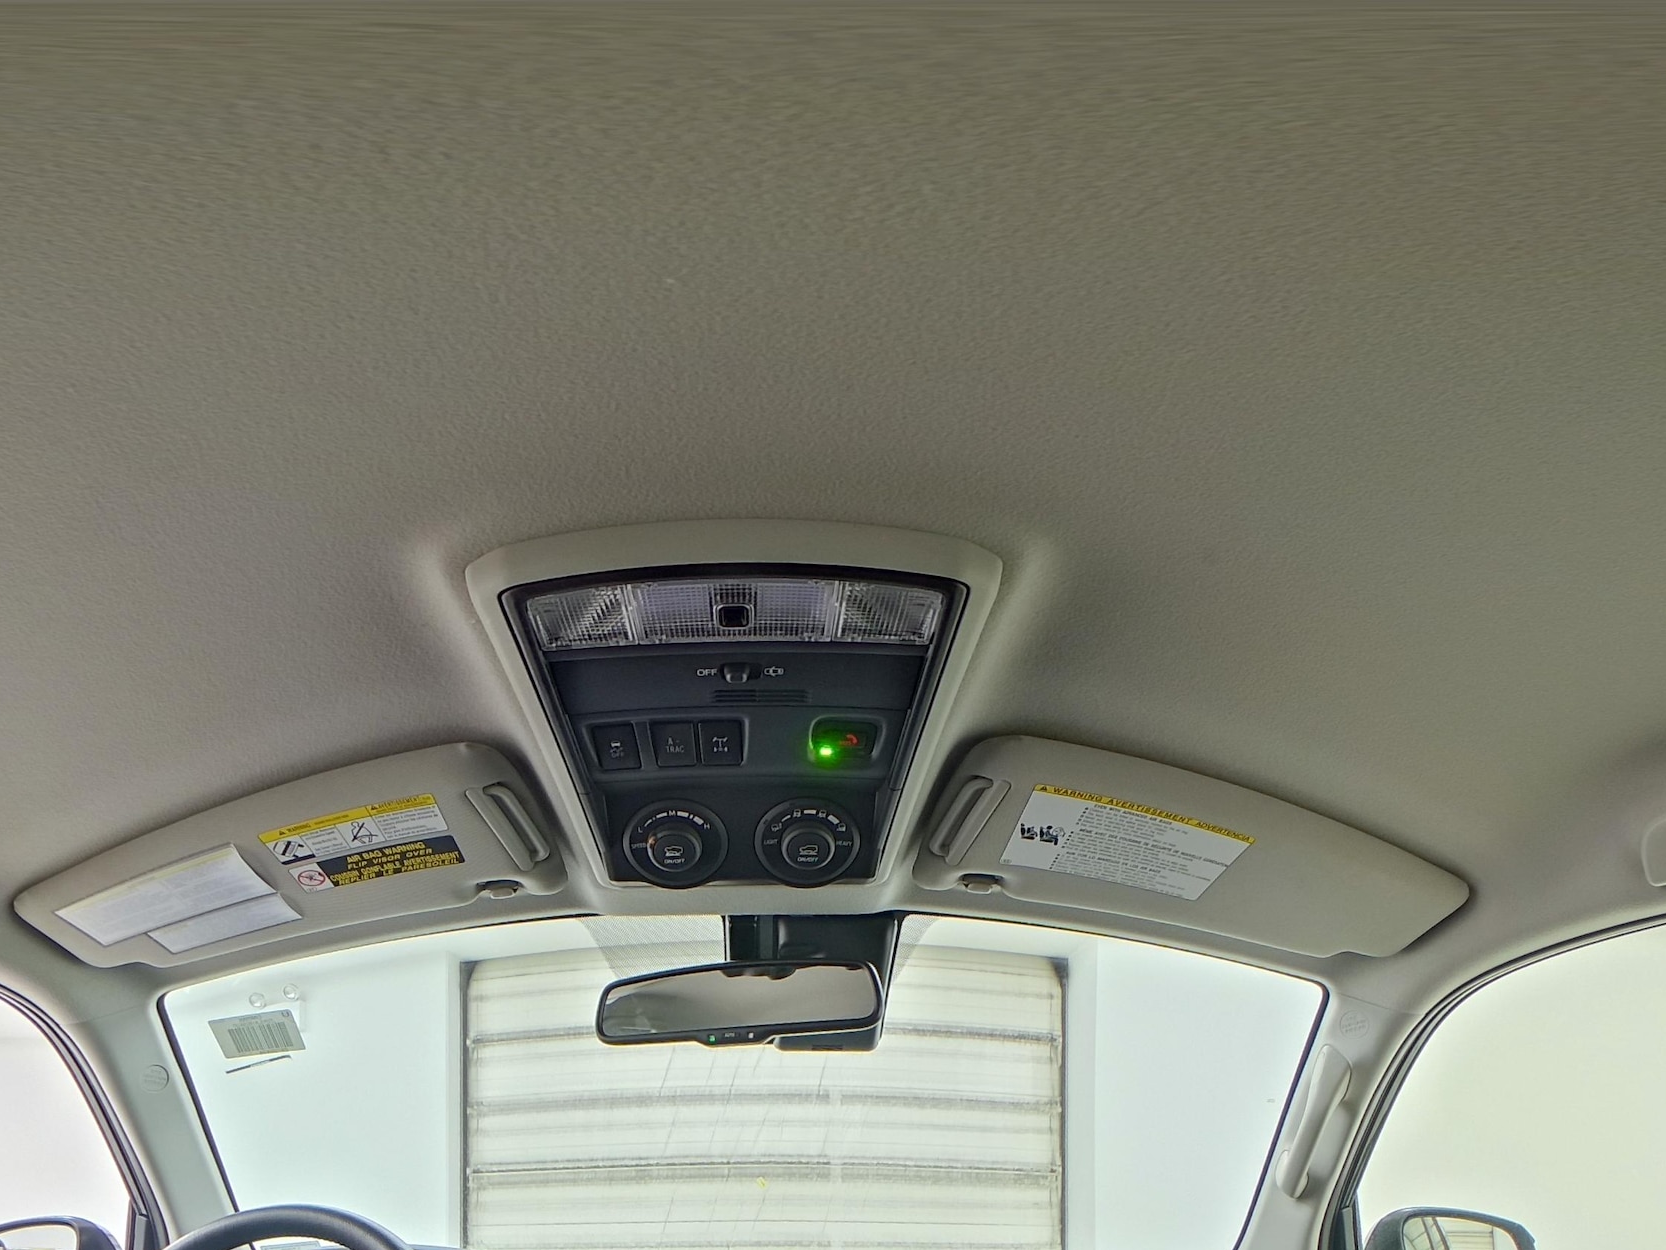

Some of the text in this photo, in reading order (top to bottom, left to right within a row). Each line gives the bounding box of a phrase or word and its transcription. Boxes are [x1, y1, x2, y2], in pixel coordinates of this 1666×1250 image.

[696, 668, 718, 677] OFF
[665, 745, 685, 753] TRAC
[1053, 785, 1104, 803] WARNING
[1109, 798, 1190, 824] AVERTISSEMENT
[668, 809, 676, 817] M
[703, 822, 711, 830] H
[763, 838, 779, 846] LIGHT
[346, 841, 426, 864] AIR BAG WARNING
[403, 850, 460, 866] AVERTISSEMENT
[347, 848, 433, 870] FLIP VISOR OVER
[339, 873, 376, 886] REPLIER
[382, 868, 395, 877] LE
